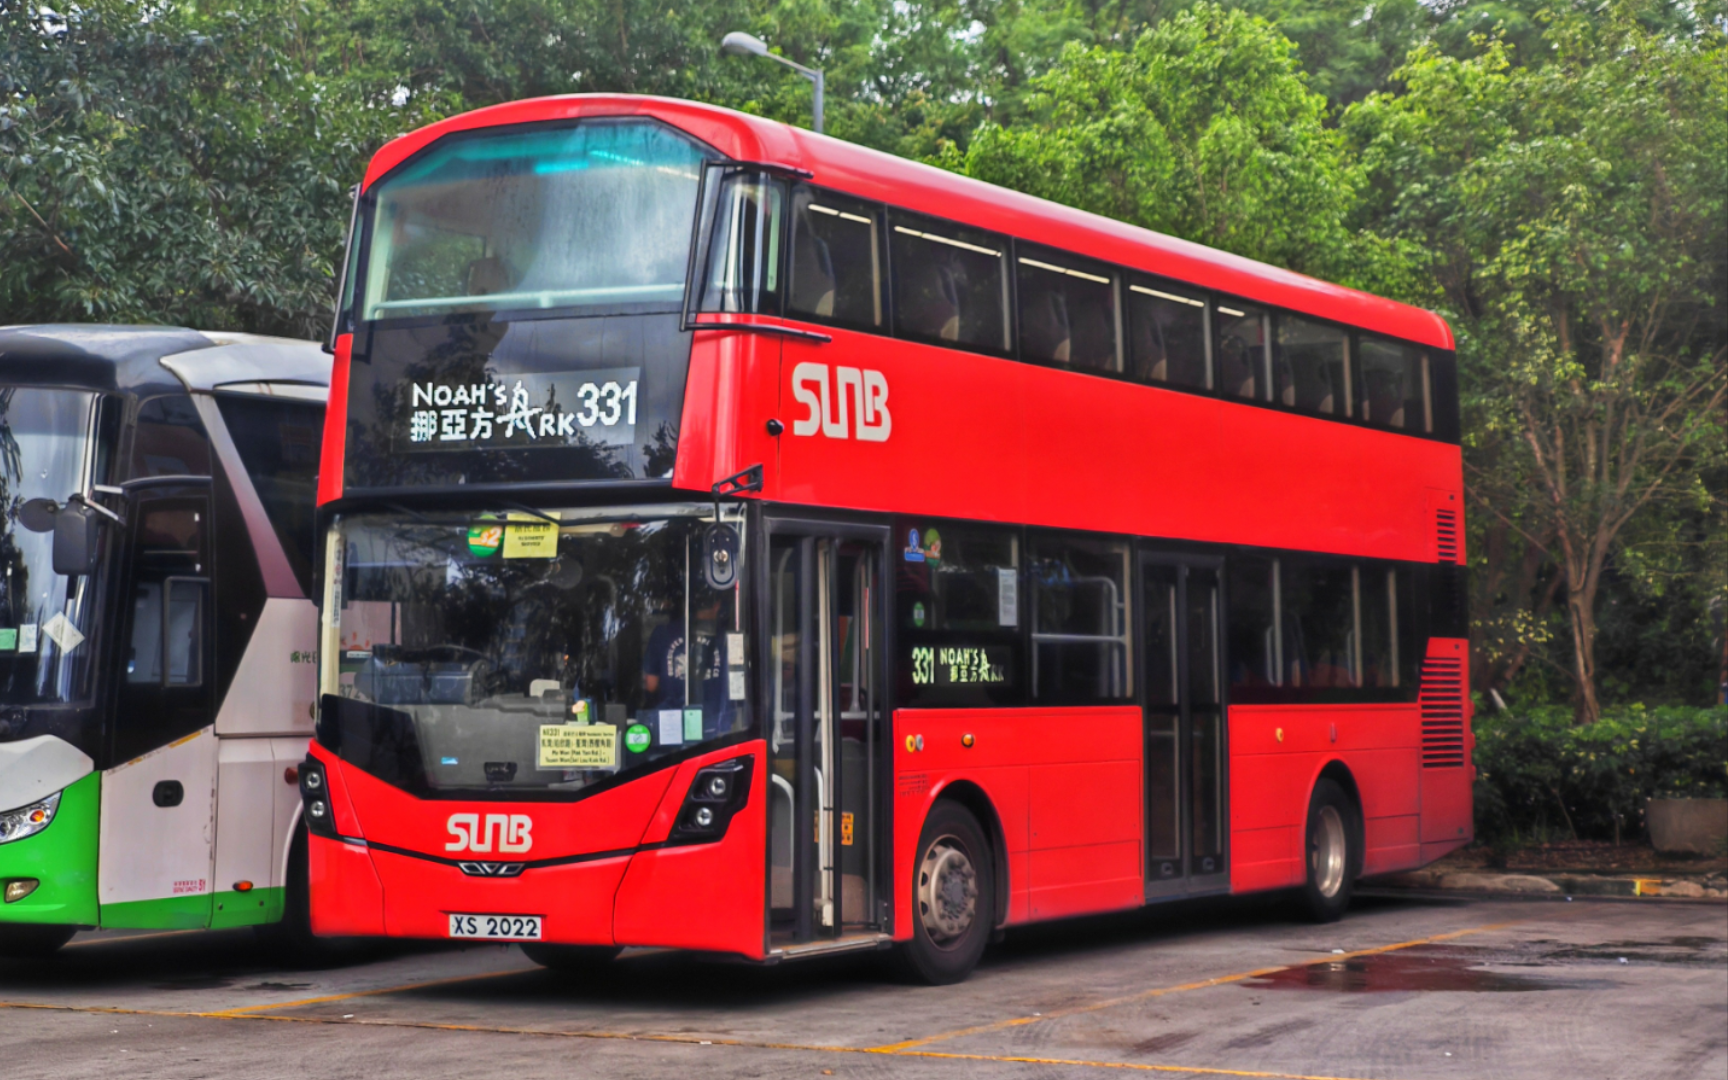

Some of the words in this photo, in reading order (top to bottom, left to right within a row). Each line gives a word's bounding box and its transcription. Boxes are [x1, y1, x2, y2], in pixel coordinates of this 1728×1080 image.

[577, 380, 637, 426] 331
[912, 647, 935, 684] 331
[454, 916, 478, 935] XS
[486, 918, 538, 937] 2022
